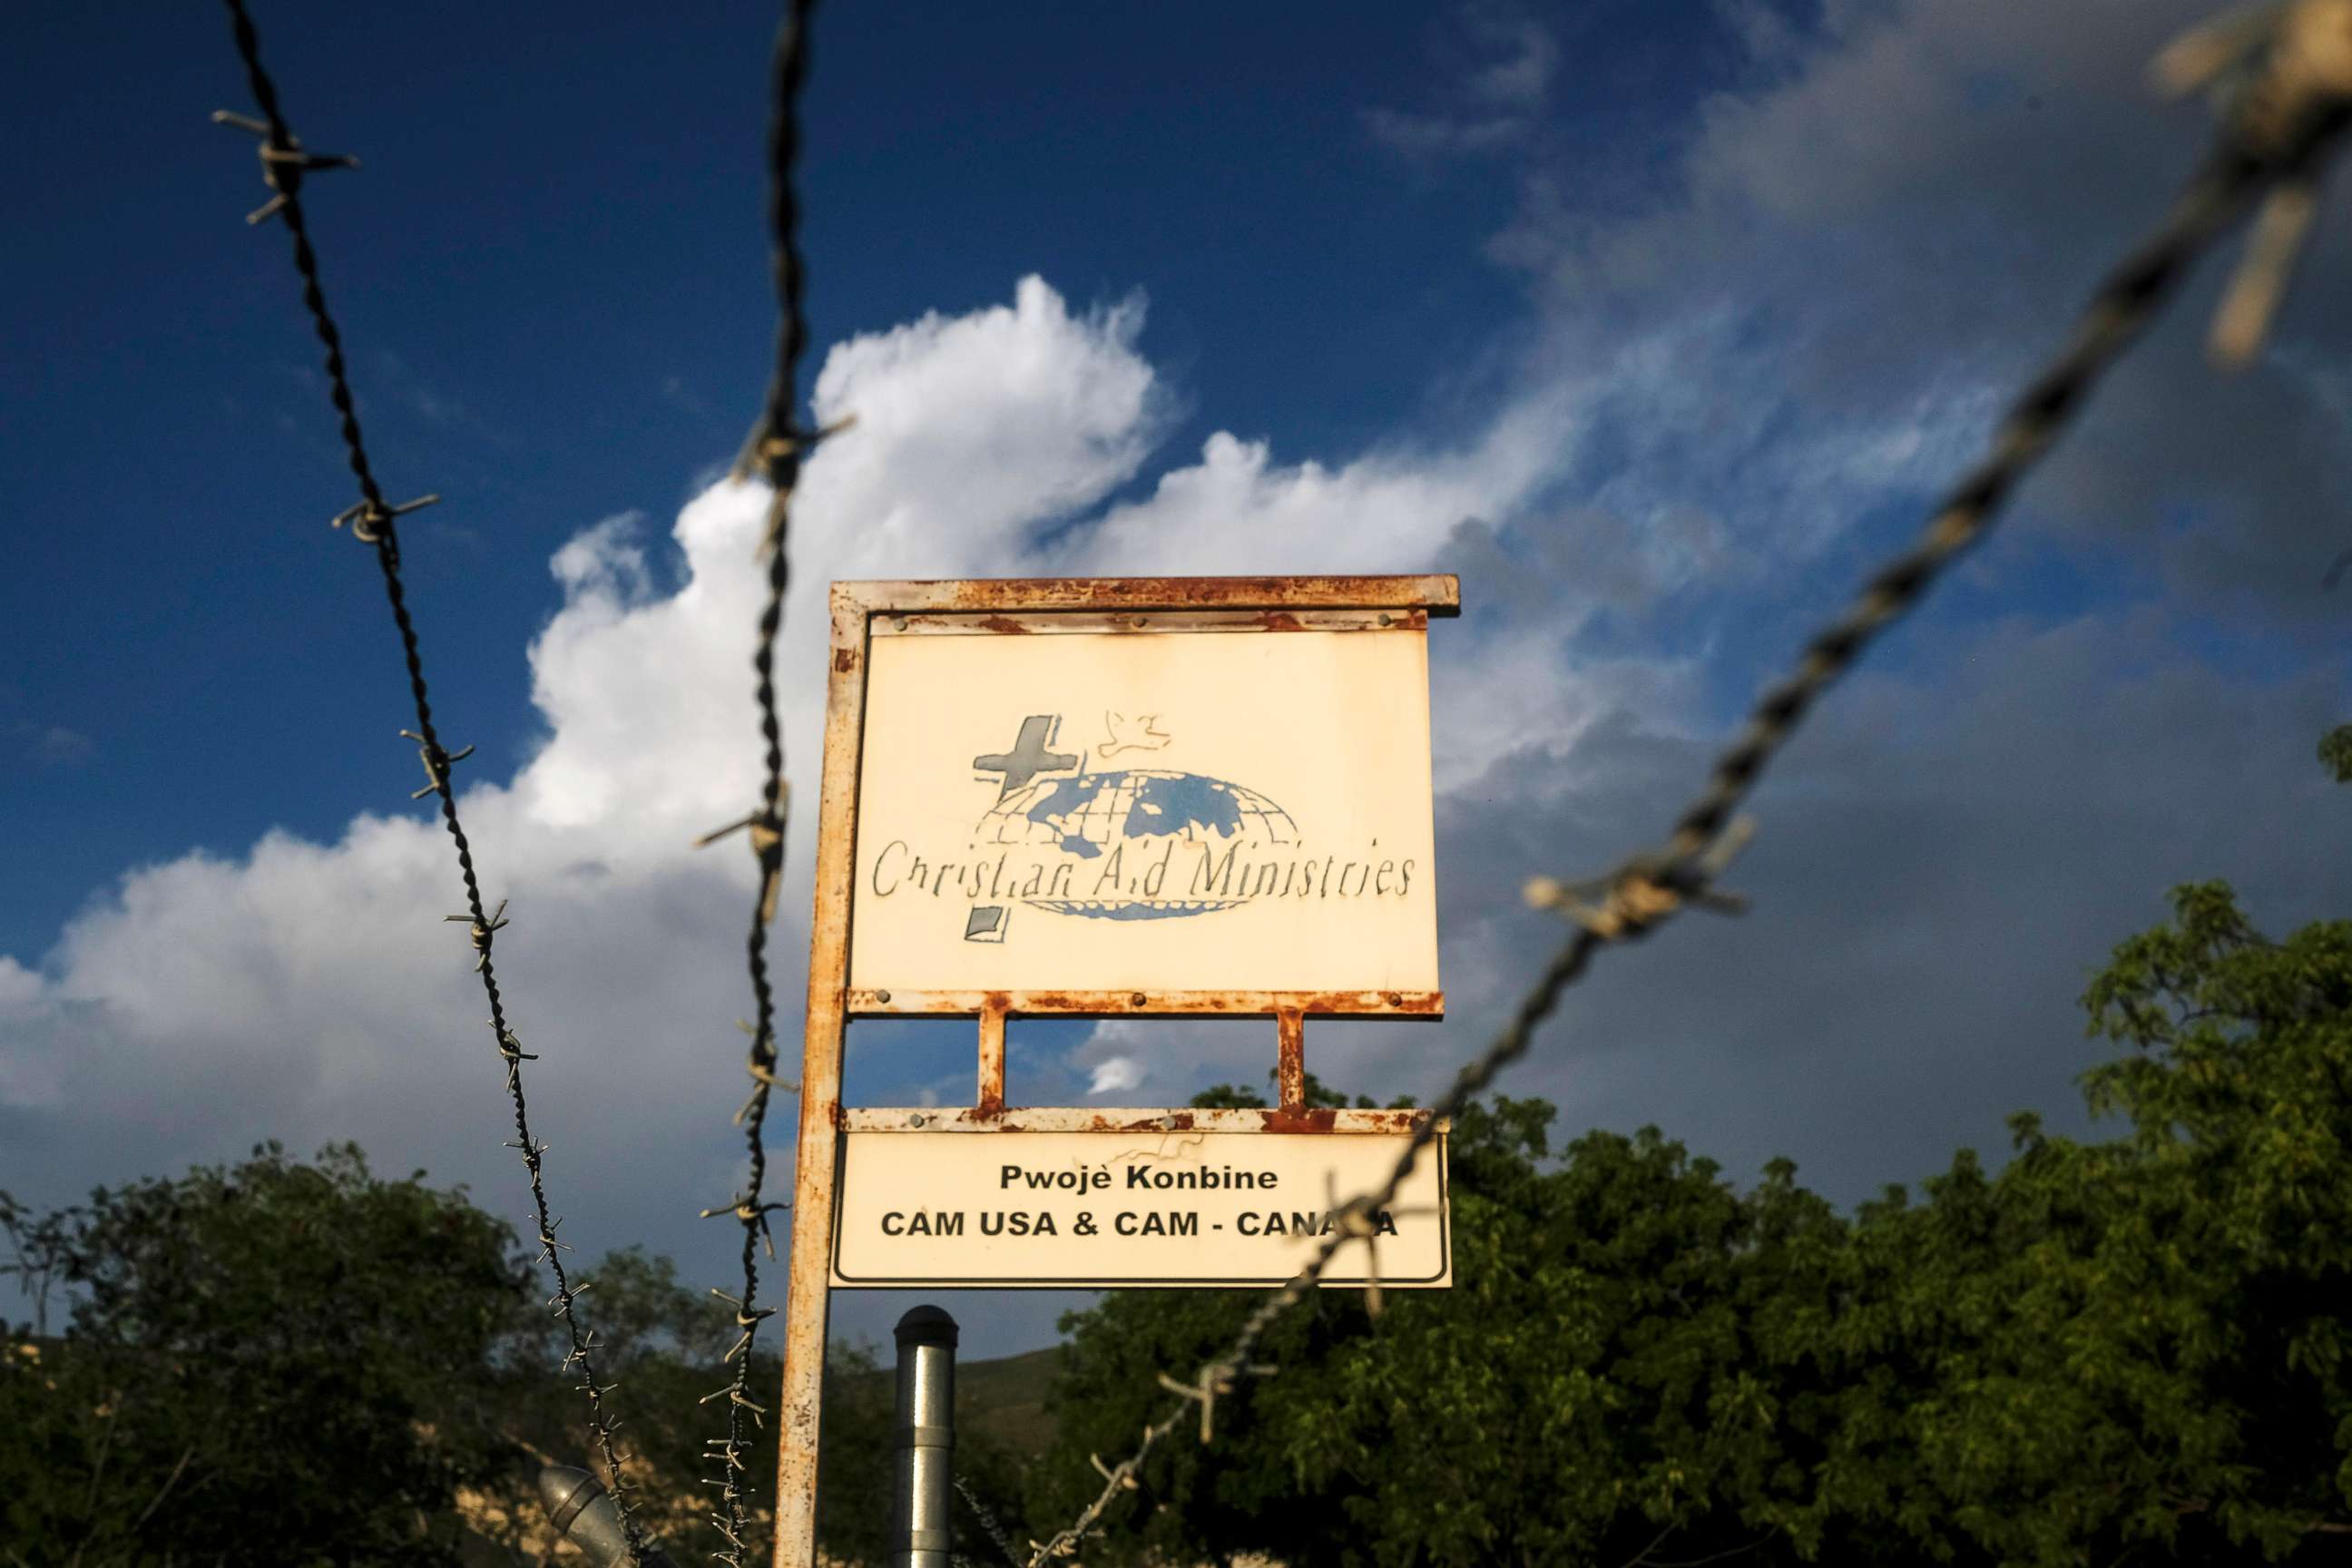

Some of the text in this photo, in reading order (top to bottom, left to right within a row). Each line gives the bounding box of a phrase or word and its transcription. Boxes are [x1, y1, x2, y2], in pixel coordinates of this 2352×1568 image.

[873, 838, 1415, 898] Christian Aid Ministries
[1000, 1163, 1279, 1195] Pwojè Konbine
[881, 1211, 965, 1236] CAM
[980, 1211, 1058, 1236] USA
[1073, 1211, 1099, 1236] &
[1115, 1211, 1199, 1237] CAM
[1236, 1211, 1399, 1237] CANAA
